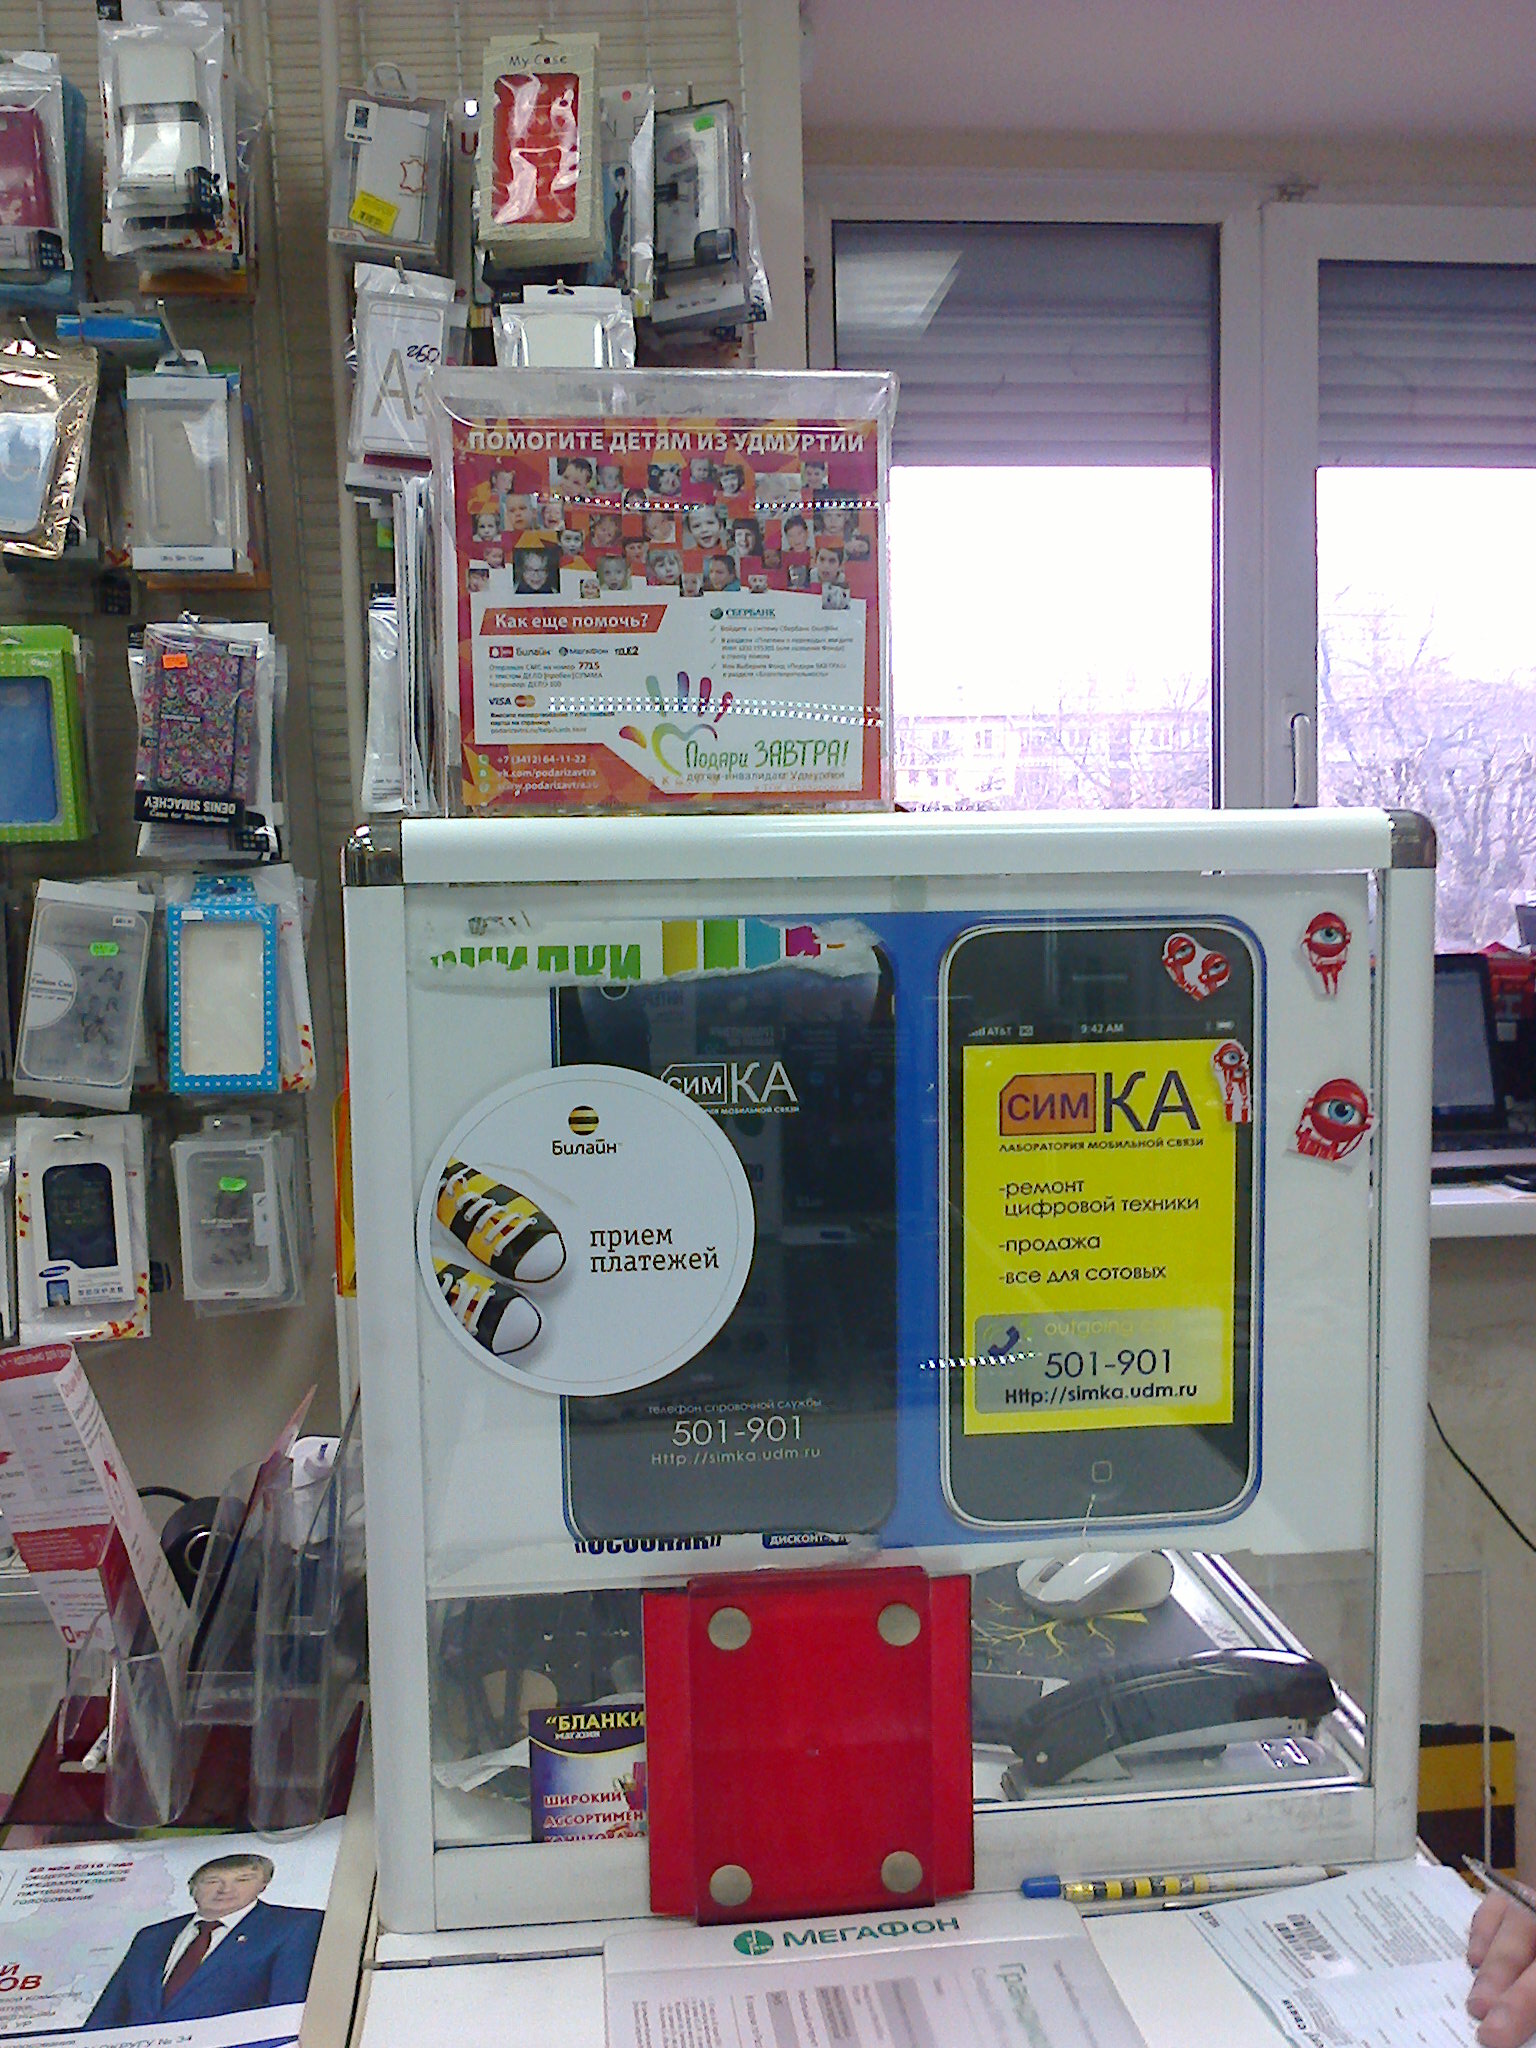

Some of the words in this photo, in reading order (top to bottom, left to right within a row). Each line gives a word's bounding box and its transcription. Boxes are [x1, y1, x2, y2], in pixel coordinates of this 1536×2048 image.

[509, 55, 529, 66] My
[533, 54, 568, 66] Case
[468, 430, 604, 452] ПОМОГИТЕ
[609, 431, 691, 455] ДЕТЯМ
[697, 432, 728, 452] ИЗ
[733, 432, 865, 456] УДМУРТИИ
[494, 613, 529, 629] Как
[531, 616, 568, 631] еще
[572, 611, 650, 628] помочь?
[725, 607, 776, 618] СБЕРБАНК
[578, 660, 600, 670] 7715
[488, 697, 512, 706] VISA
[497, 754, 510, 764] +7
[685, 739, 750, 772] Подари
[753, 738, 850, 769] ЗАВТРА!
[143, 795, 201, 812] SIMACHEV
[203, 800, 236, 815] DENIS
[1104, 1022, 1125, 1034] AM
[552, 1138, 618, 1156] Билайн
[999, 1141, 1086, 1153] ЛАБОРАТОРИЯ
[1086, 1138, 1165, 1151] МОБИЛЬНОЙ
[1166, 1137, 1205, 1149] СВЯЗИ
[999, 1179, 1085, 1200] -ремонт
[1004, 1195, 1116, 1218] цифровой
[1121, 1196, 1200, 1213] техники
[590, 1227, 673, 1253] прием
[998, 1234, 1101, 1256] -продажа
[590, 1247, 720, 1274] платежей
[999, 1270, 1042, 1285] -все
[1046, 1269, 1080, 1284] для
[1085, 1265, 1168, 1282] сотовых
[1044, 1318, 1135, 1339] outgoing
[1043, 1348, 1173, 1379] 501-901
[1004, 1382, 1198, 1408] Http://simka.udm.ru
[672, 1415, 802, 1447] 501-901
